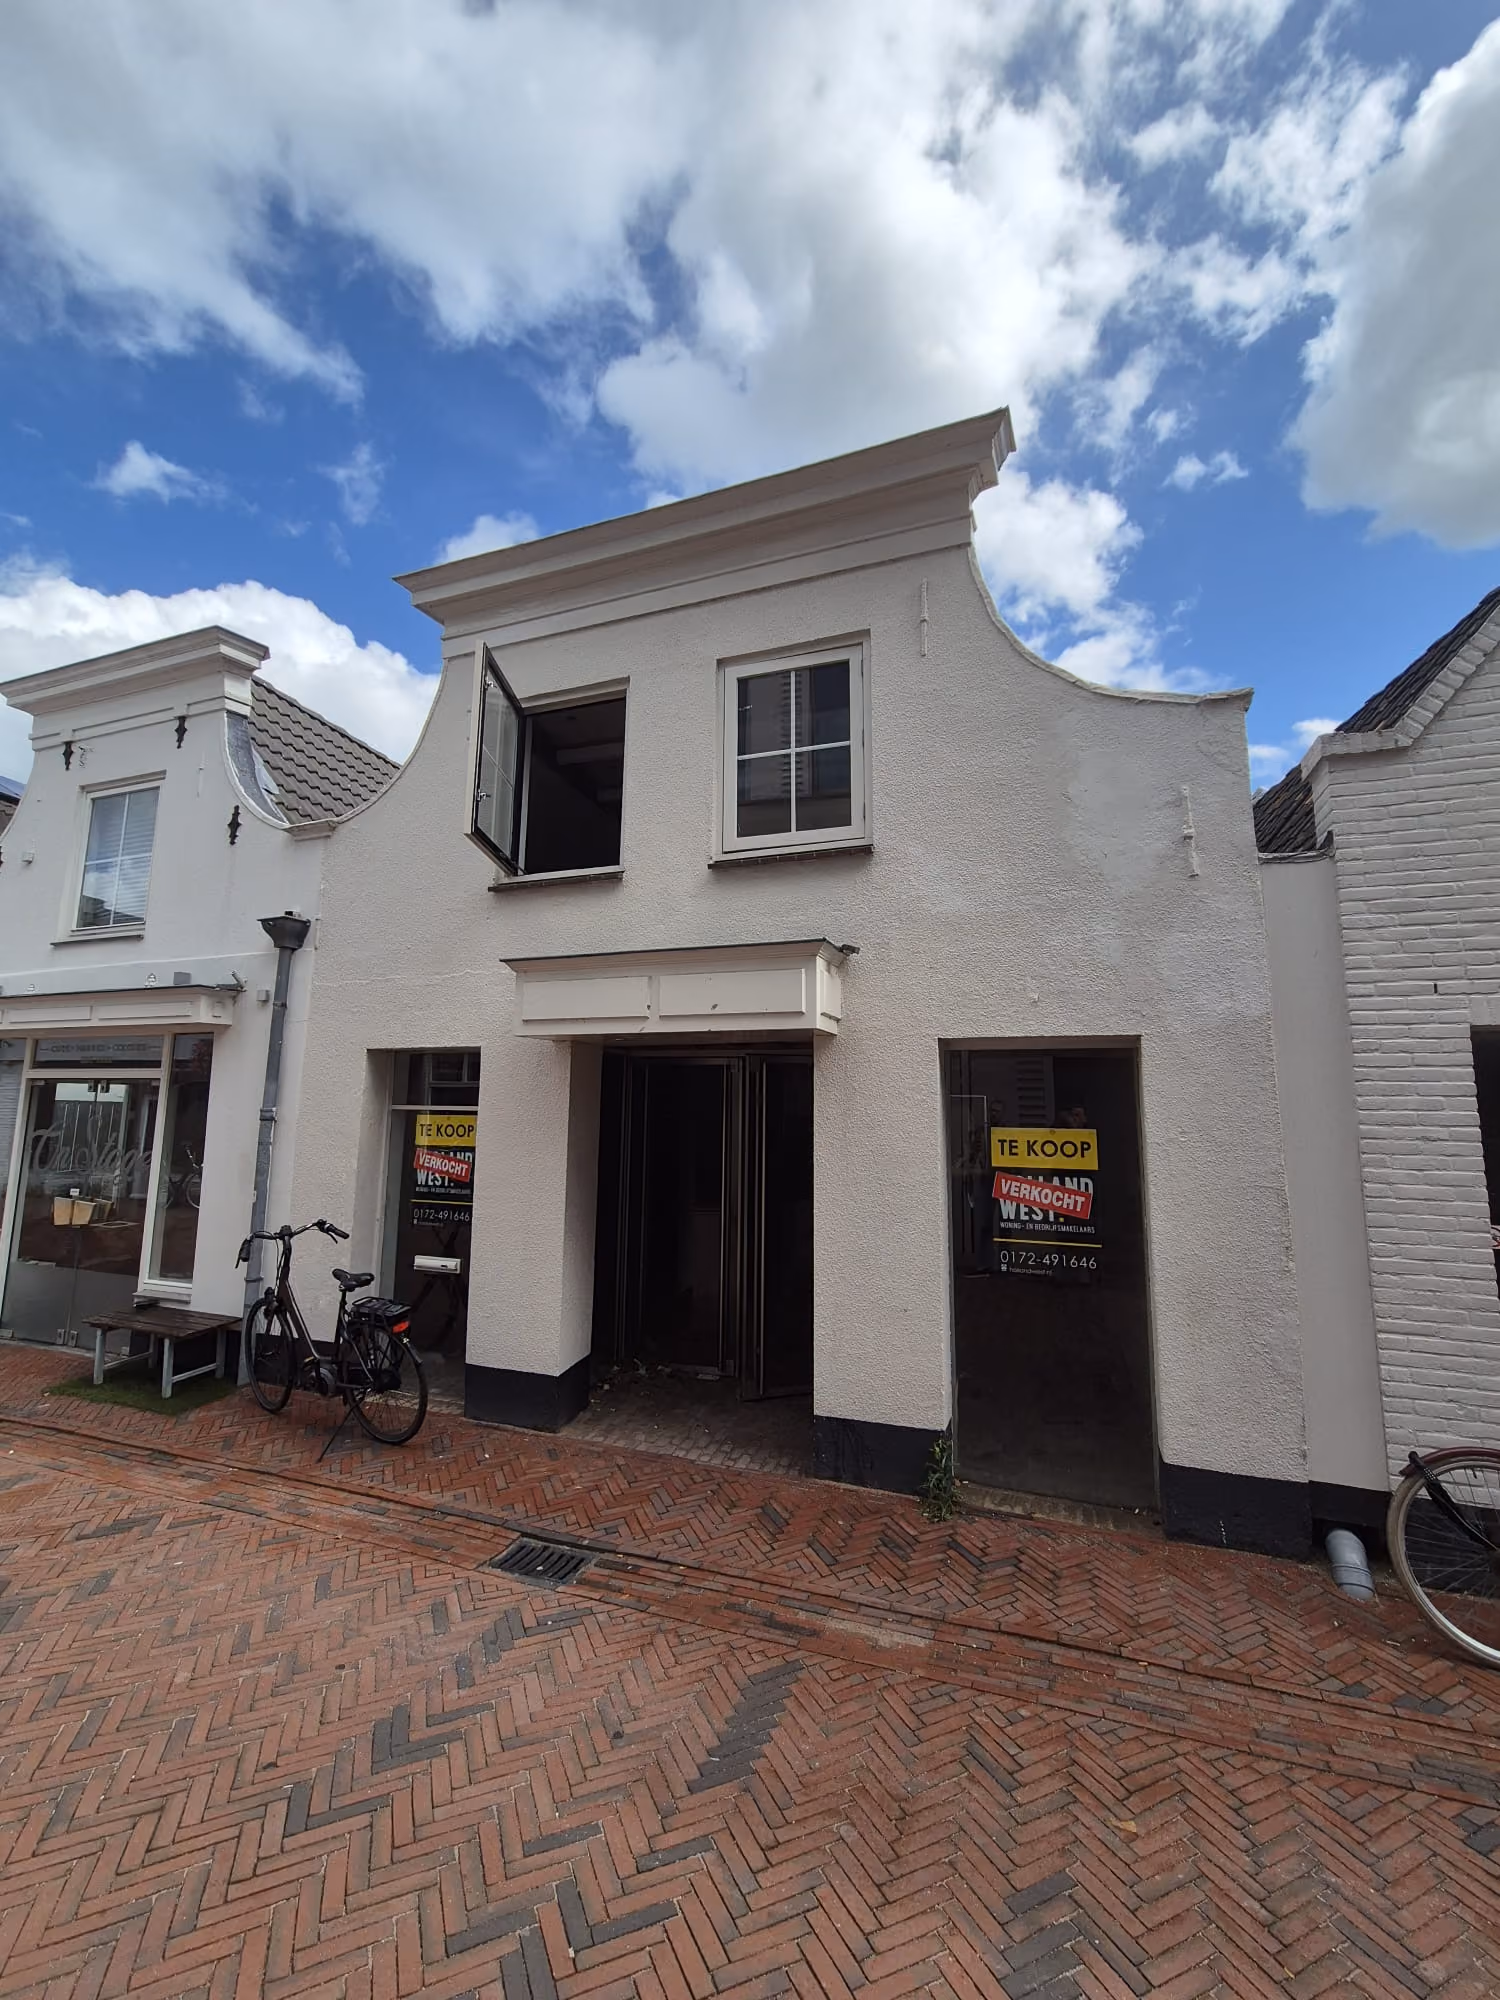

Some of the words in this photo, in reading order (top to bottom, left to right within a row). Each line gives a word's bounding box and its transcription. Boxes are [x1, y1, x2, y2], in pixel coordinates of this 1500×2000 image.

[419, 1123, 433, 1137] TE
[436, 1124, 475, 1138] KOOP
[997, 1139, 1019, 1156] TE
[1027, 1140, 1092, 1158] KOOP
[419, 1153, 468, 1177] VERKOCHT
[1001, 1178, 1086, 1212] VERKOCHT
[413, 1209, 470, 1222] 0172-491646
[1000, 1251, 1097, 1269] 0172-491646
